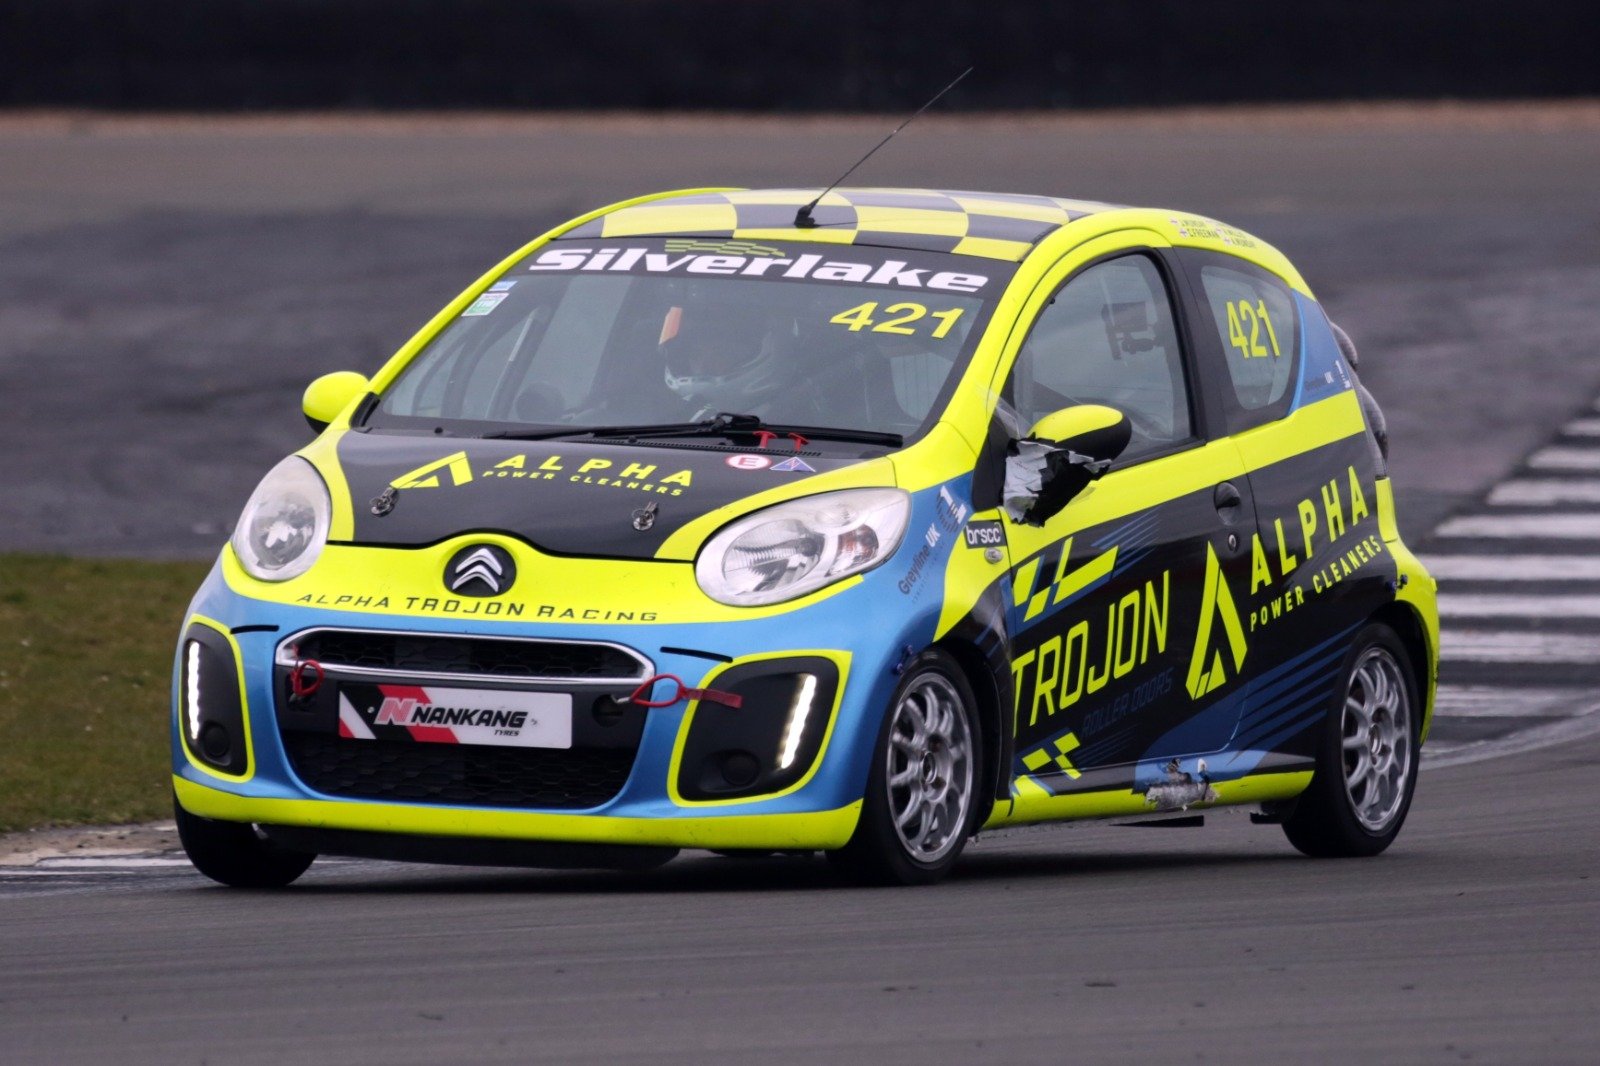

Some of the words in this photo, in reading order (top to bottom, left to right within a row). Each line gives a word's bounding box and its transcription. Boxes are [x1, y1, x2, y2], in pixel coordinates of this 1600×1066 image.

[529, 248, 989, 293] Silverlake
[830, 301, 965, 339] 421
[1227, 299, 1280, 358] 421
[483, 470, 554, 481] POWER
[570, 475, 683, 497] CLEANERS
[494, 454, 693, 488] ALPHA
[965, 524, 1001, 545] brscc
[1250, 465, 1369, 595] ALPHA
[898, 545, 929, 595] Greyline
[925, 522, 941, 548] UK
[1250, 584, 1304, 633] POWER
[1312, 534, 1382, 595] CLEANERS
[296, 594, 390, 609] ALPHA
[406, 597, 525, 616] TROJON
[537, 606, 659, 622] RACING
[1011, 569, 1170, 739] TROJON
[410, 706, 529, 728] NANKANG
[494, 729, 520, 737] TYRES
